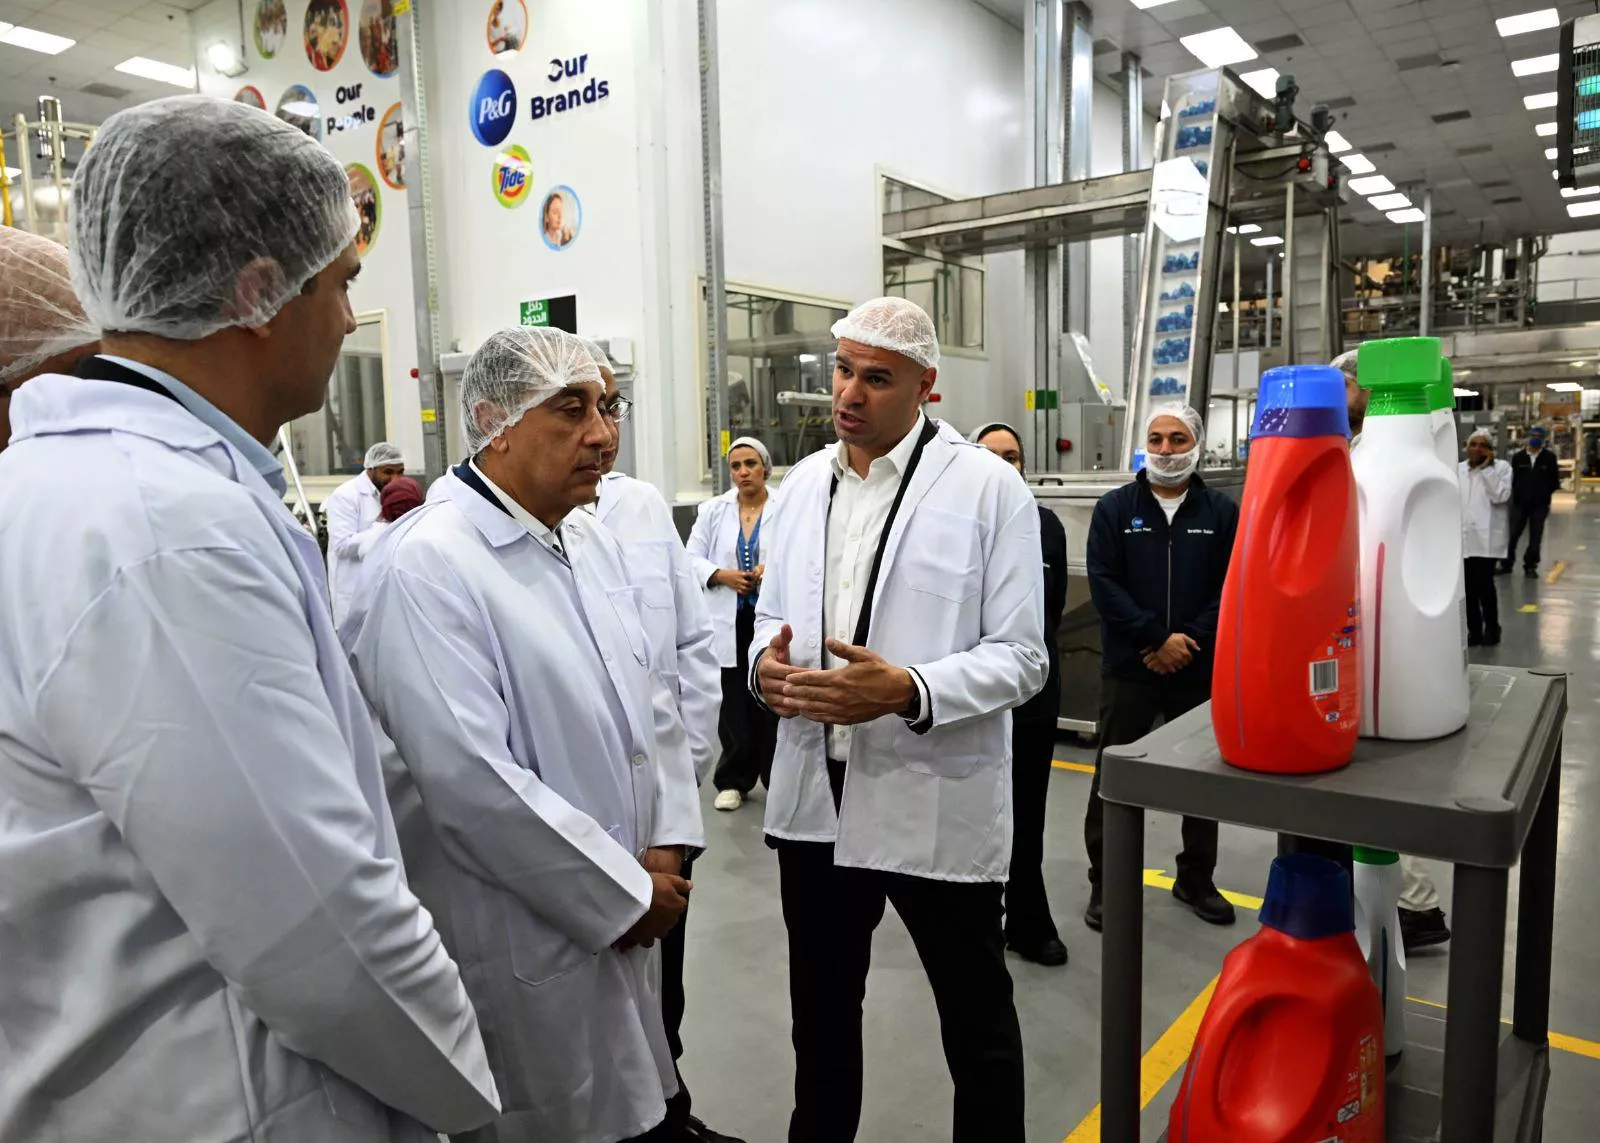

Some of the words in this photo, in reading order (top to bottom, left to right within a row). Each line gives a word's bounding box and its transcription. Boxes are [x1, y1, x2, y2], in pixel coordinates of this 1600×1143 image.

[548, 53, 588, 82] Our
[336, 83, 362, 104] Our
[479, 90, 511, 124] P&G
[531, 77, 609, 120] Brands
[327, 104, 375, 135] Pple
[499, 166, 525, 194] Tide
[525, 301, 543, 315] داخل
